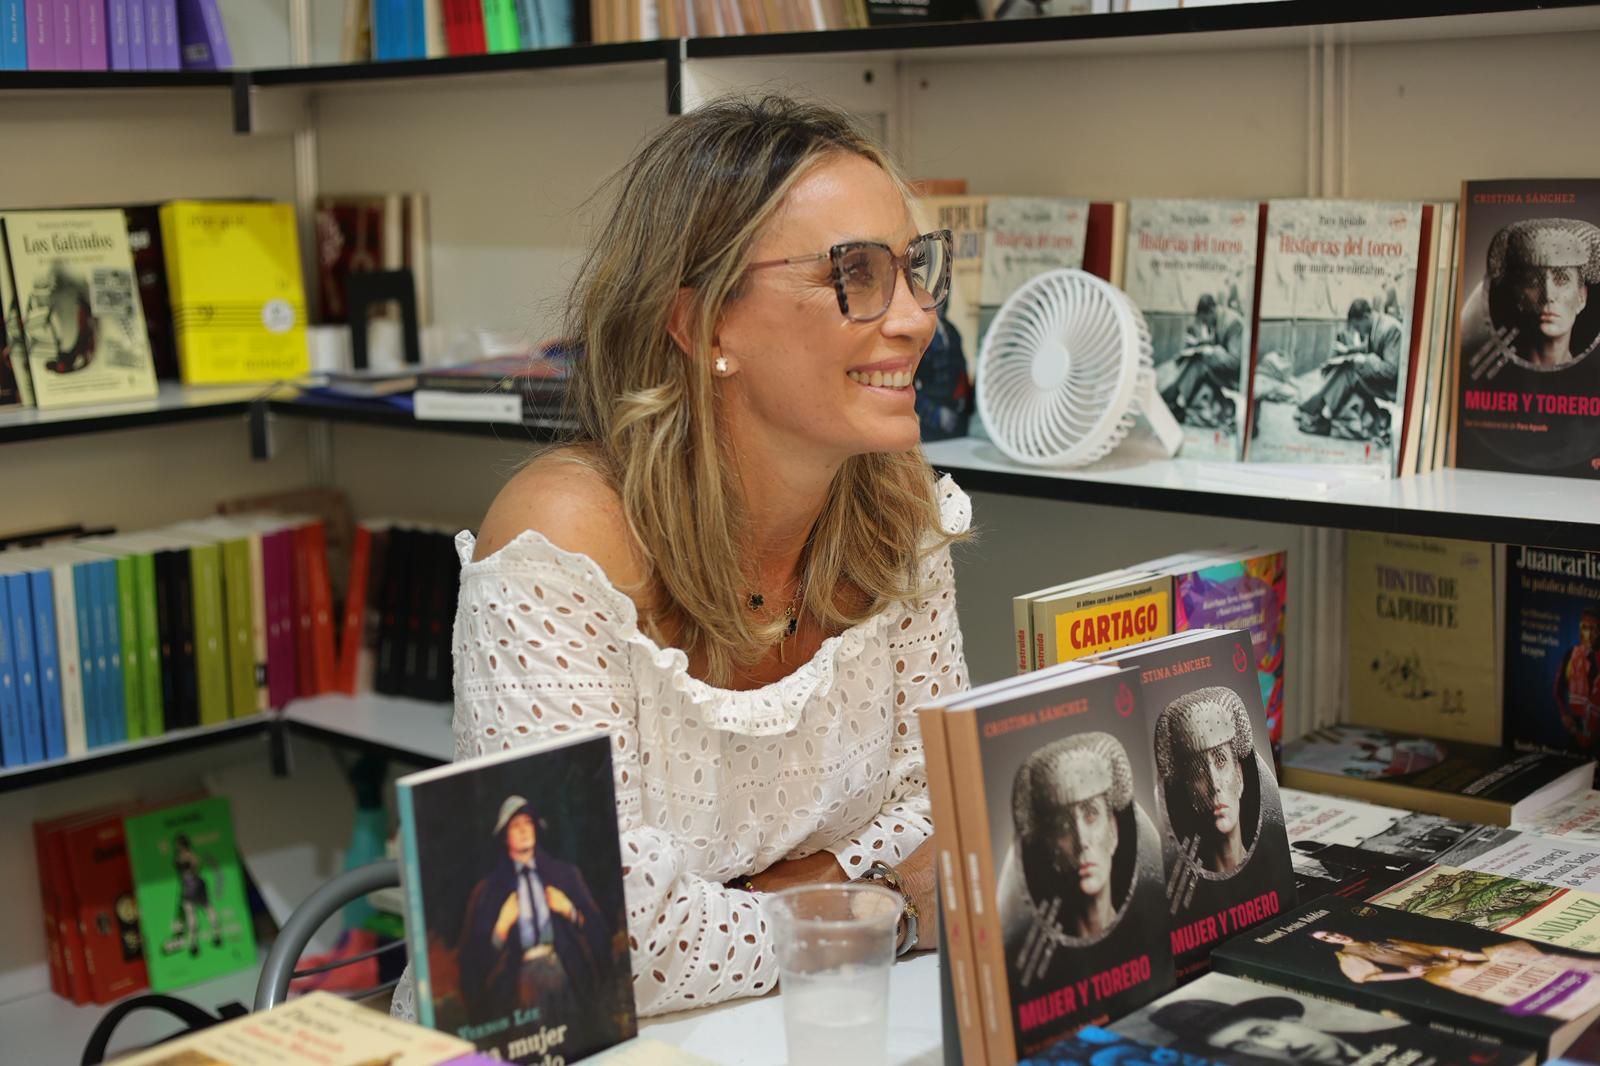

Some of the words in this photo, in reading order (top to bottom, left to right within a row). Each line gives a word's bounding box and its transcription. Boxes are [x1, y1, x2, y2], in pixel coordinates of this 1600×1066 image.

[1279, 232, 1340, 257] Historias
[1343, 235, 1363, 256] del
[1368, 240, 1402, 257] toreo
[1464, 389, 1518, 411] MUJER
[1521, 392, 1533, 412] Y
[1536, 394, 1600, 416] TORERO
[1438, 577, 1459, 600] DE
[1070, 603, 1158, 650] CARTAGO
[1018, 629, 1026, 670] destruida
[1037, 633, 1045, 670] estruida
[1142, 667, 1172, 684] STINA
[1172, 656, 1212, 676] SÁNCHEZ
[984, 711, 1037, 738] CRISTINA
[1170, 915, 1218, 956] MUJER
[1218, 910, 1229, 935] Y
[1229, 891, 1280, 930] TORERO
[1527, 898, 1600, 941] ANDALUZ
[1019, 985, 1077, 1032] MUJER
[1076, 979, 1089, 1007] Y
[1091, 955, 1152, 1001] TORERO
[508, 1024, 568, 1061] mujer
